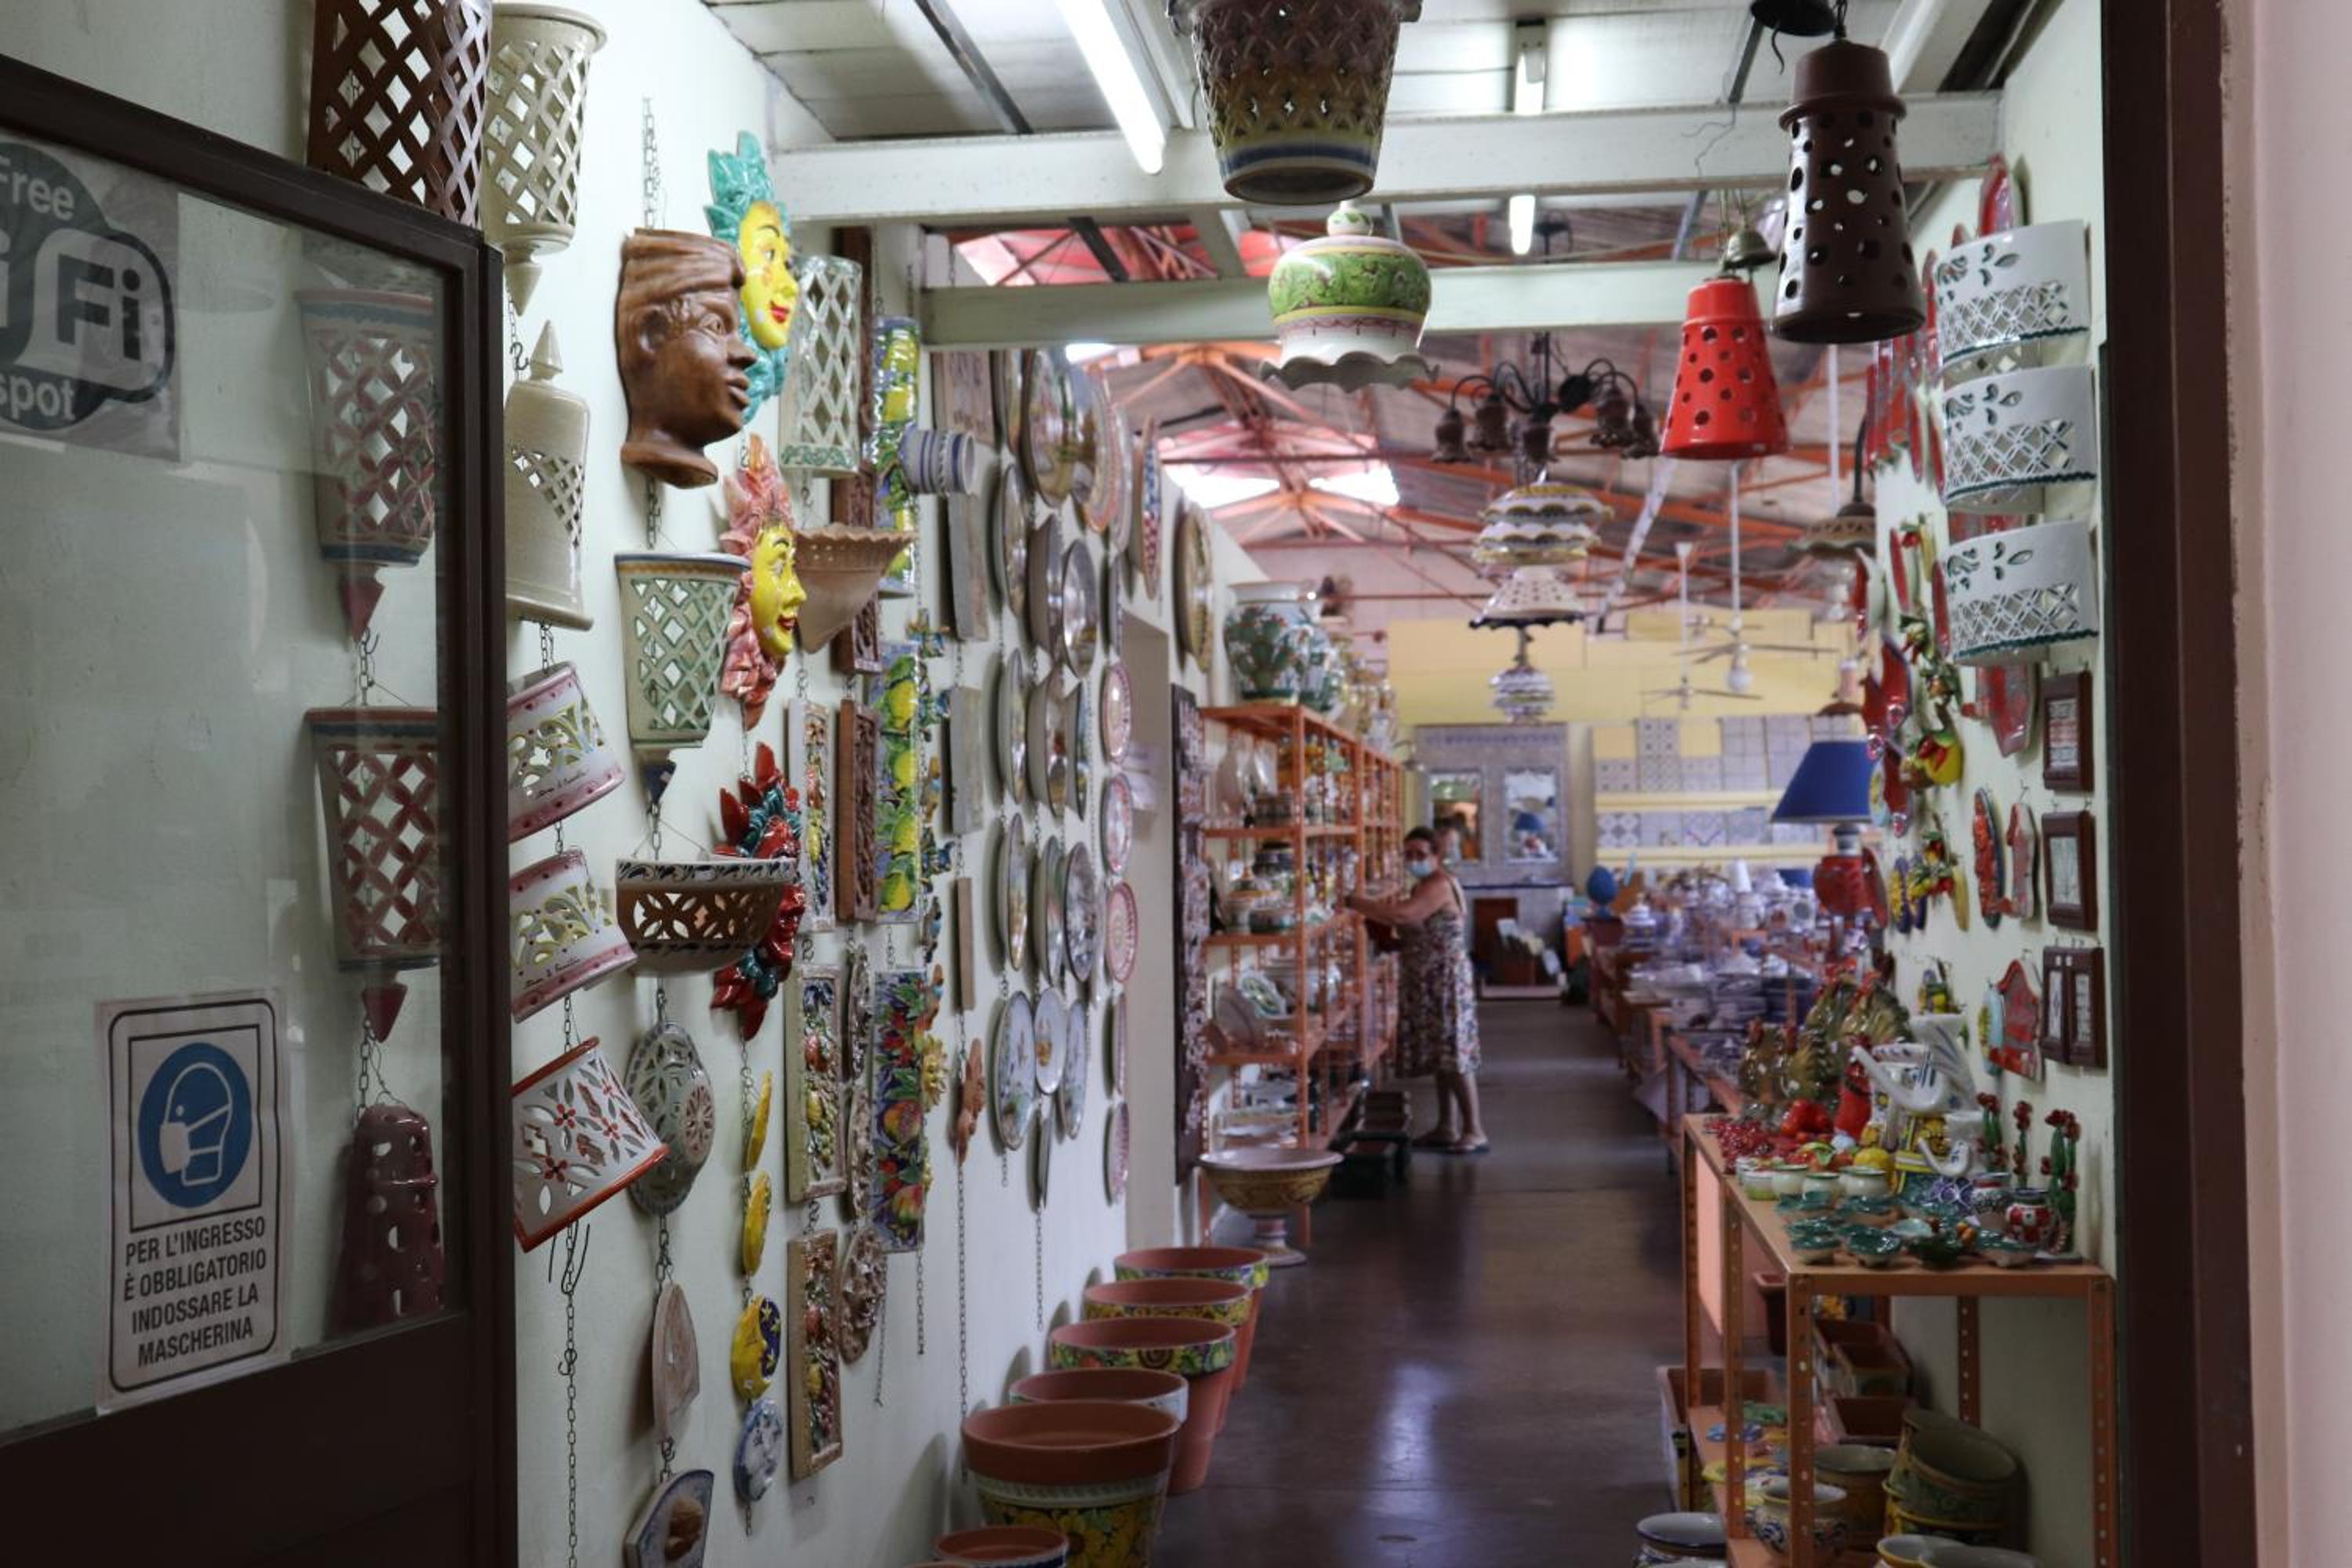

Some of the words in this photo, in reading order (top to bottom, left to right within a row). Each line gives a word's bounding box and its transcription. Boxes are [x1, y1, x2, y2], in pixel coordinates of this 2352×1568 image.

[57, 253, 141, 361] Fi
[125, 1238, 159, 1267] PER
[165, 1216, 265, 1258] L'INGRESSO
[124, 1272, 135, 1301] È
[140, 1248, 267, 1298] OBBLIGATORIO
[132, 1288, 233, 1334] INDOSSARE
[238, 1283, 259, 1307] LA
[137, 1316, 253, 1368] MASCHERINA
